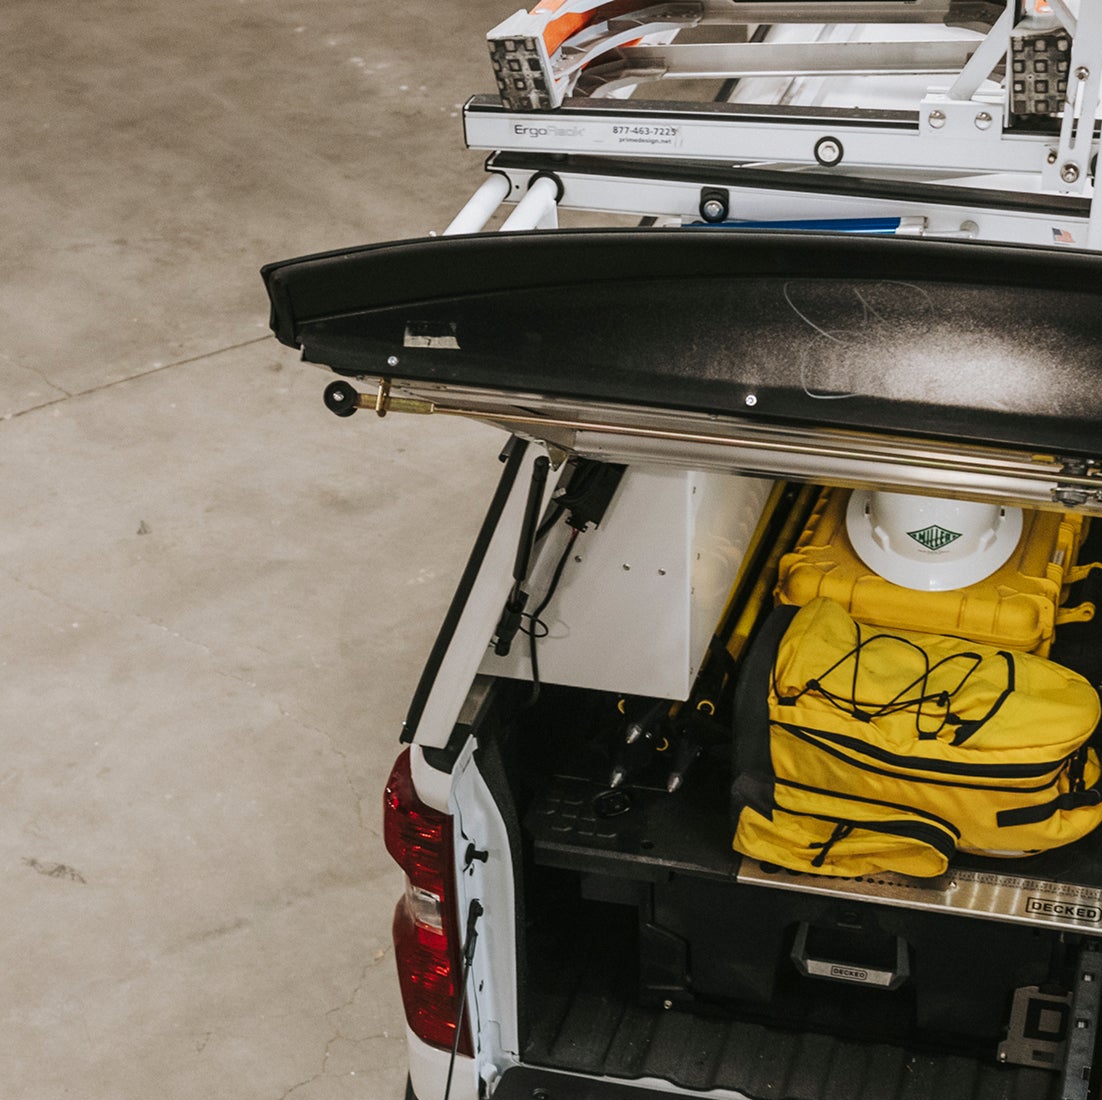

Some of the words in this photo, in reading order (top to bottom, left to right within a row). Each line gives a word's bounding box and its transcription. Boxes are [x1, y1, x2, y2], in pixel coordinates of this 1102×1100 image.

[916, 527, 953, 548] MILLER
[1031, 900, 1097, 920] DECKED
[833, 967, 866, 979] DECKED
